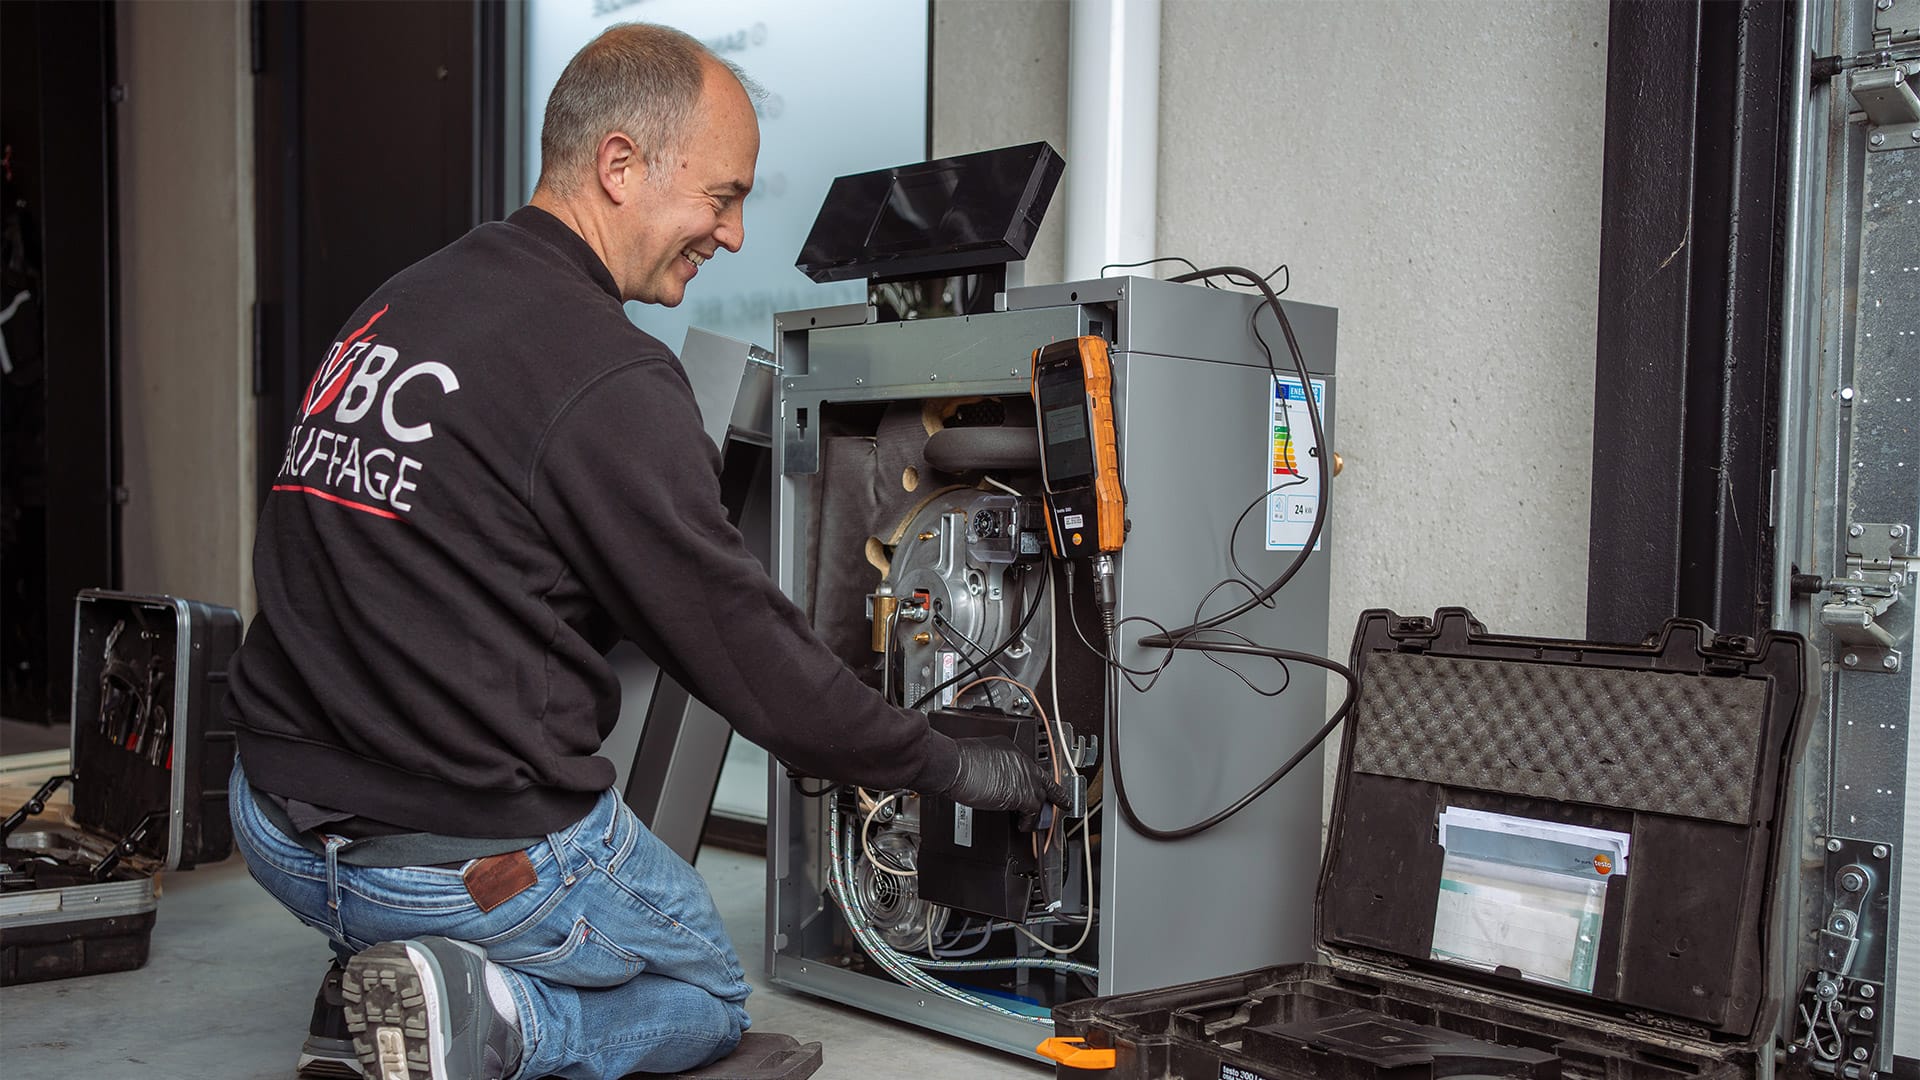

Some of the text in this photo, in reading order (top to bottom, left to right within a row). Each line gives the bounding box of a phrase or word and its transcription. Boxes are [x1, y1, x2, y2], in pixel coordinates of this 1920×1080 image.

[1294, 504, 1304, 515] 24
[1594, 859, 1613, 869] testo
[1222, 1065, 1240, 1077] testo
